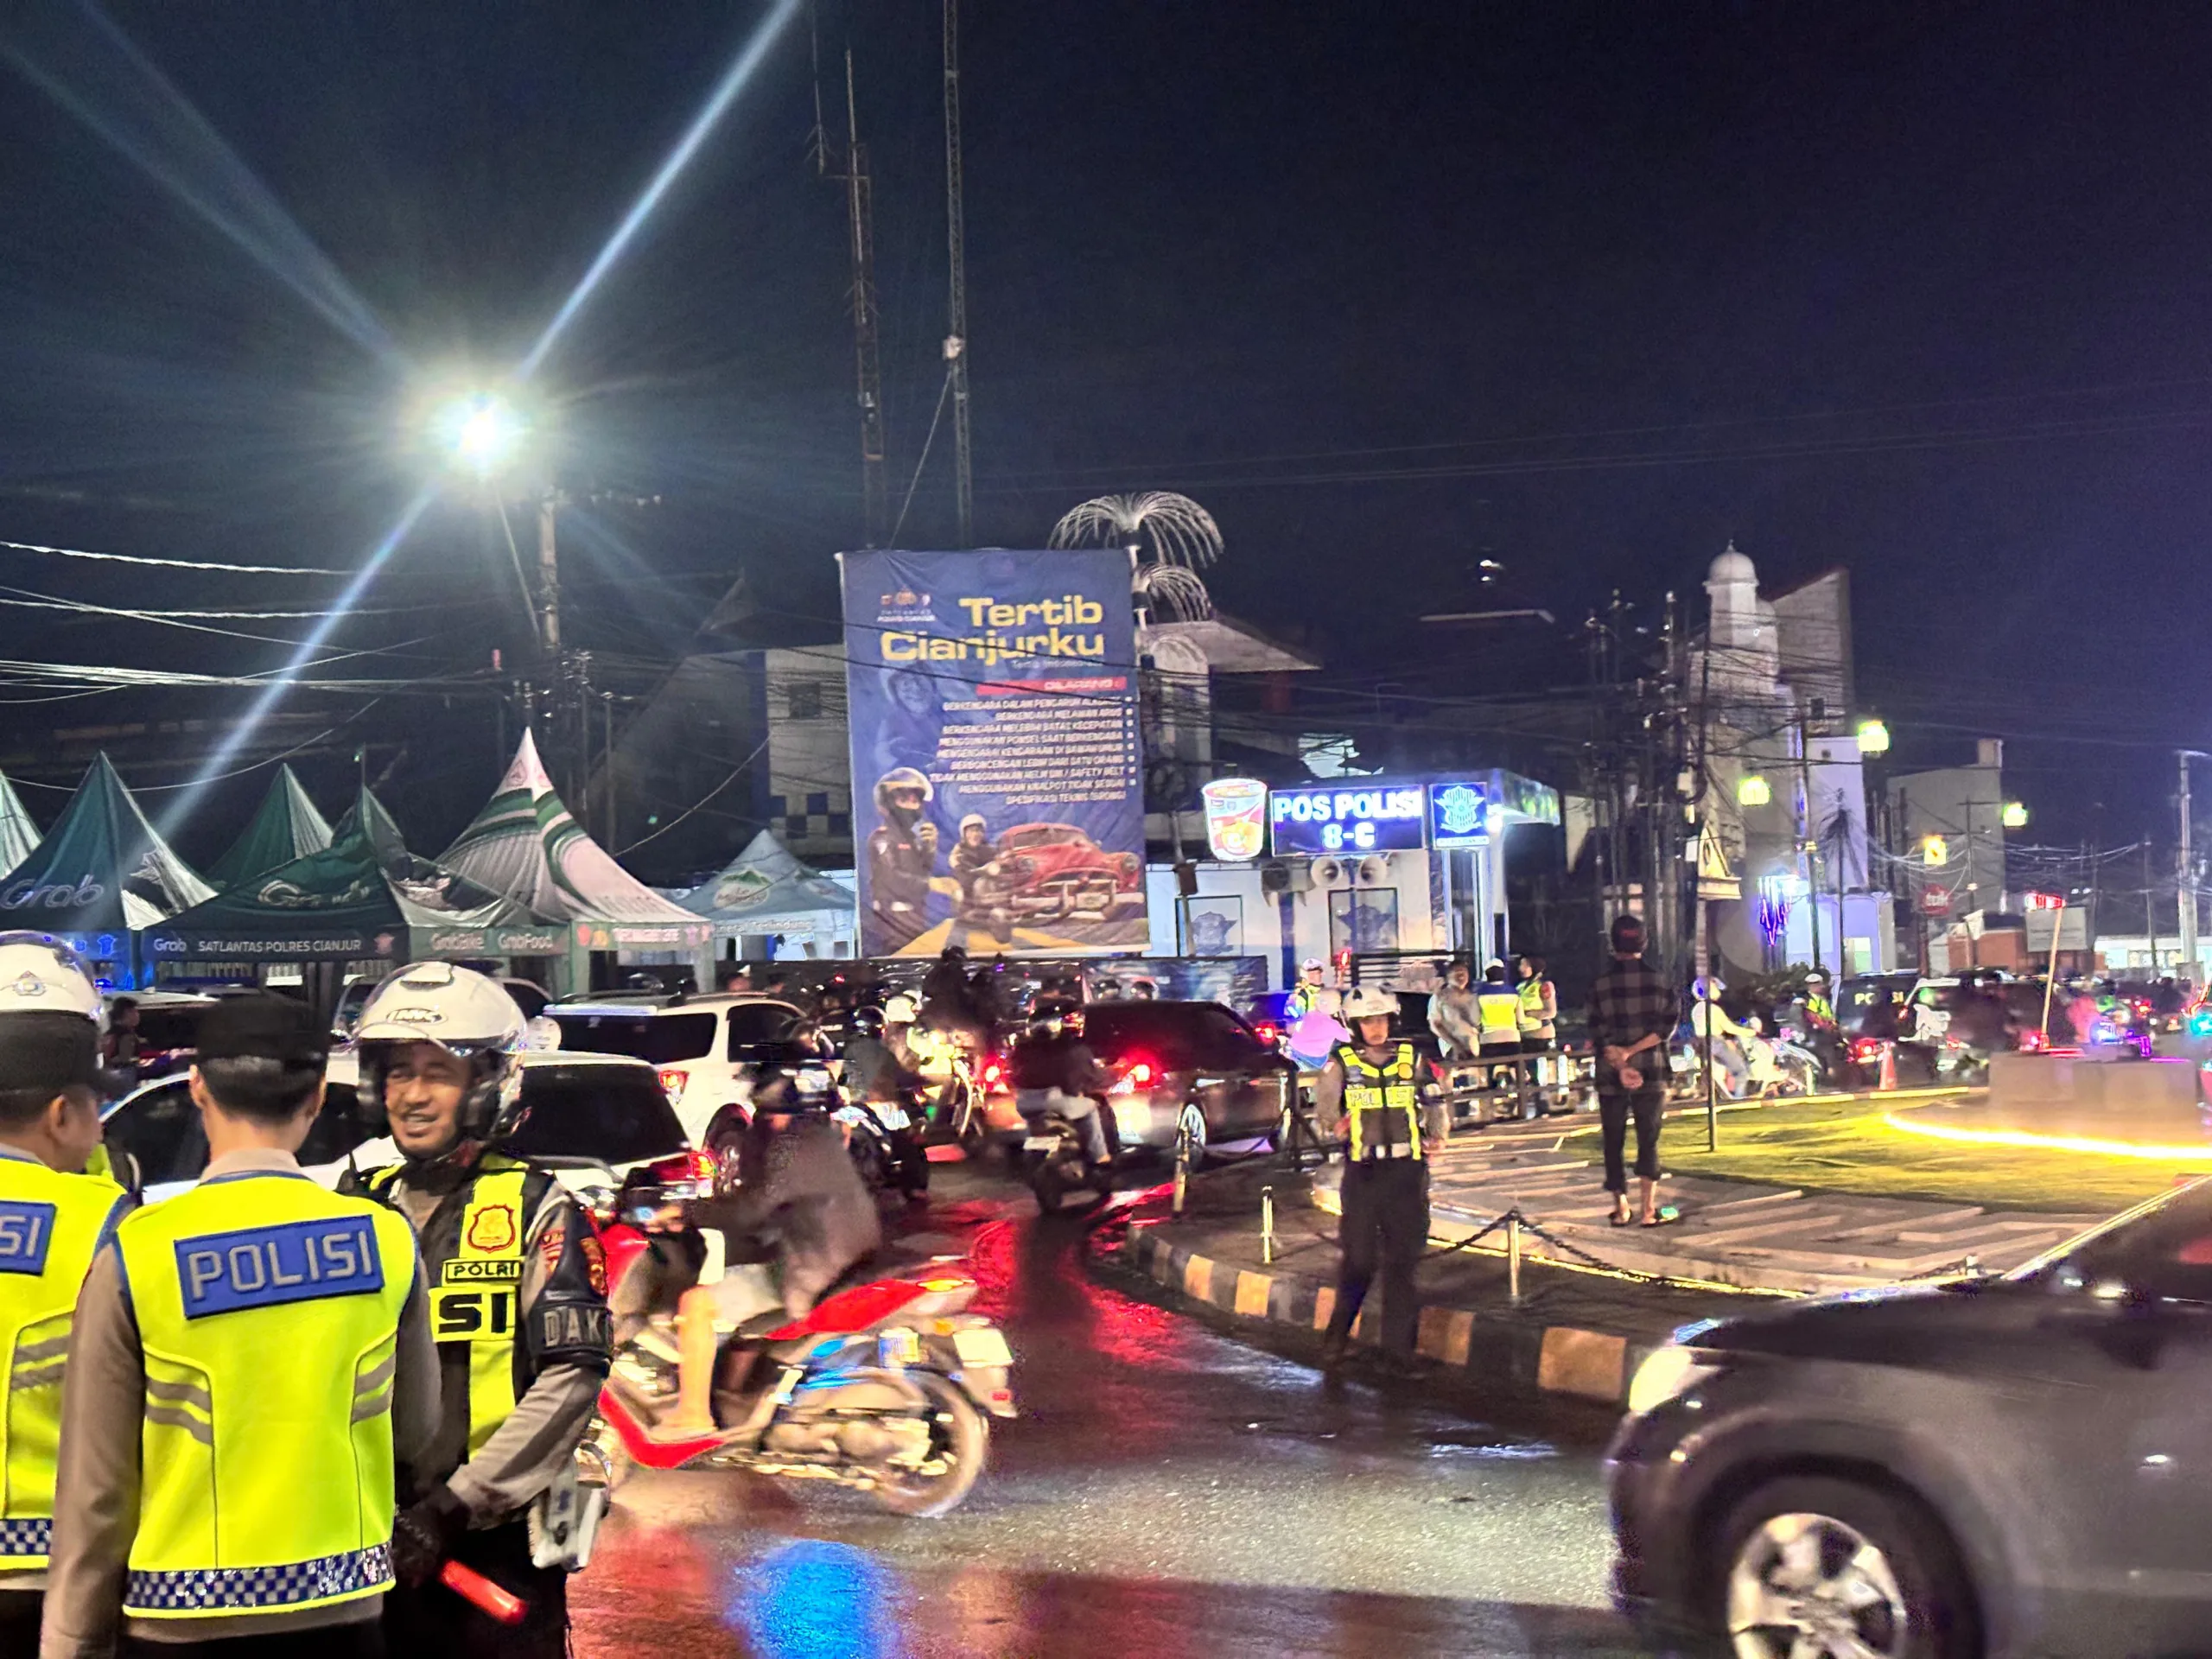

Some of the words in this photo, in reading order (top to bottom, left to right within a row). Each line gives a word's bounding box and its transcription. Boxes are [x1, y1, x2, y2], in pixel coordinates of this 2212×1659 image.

[959, 594, 1103, 626] Tertib
[880, 628, 1104, 666] Cianjurku
[1274, 793, 1332, 822] POS
[1336, 791, 1422, 819] POLISI
[1323, 823, 1376, 849] 8-C
[1, 874, 105, 910] Grab
[153, 938, 188, 951] Grab
[198, 941, 263, 952] SATLANTAS
[266, 940, 310, 951] POLRES
[313, 939, 361, 951] CIANJUR
[499, 932, 553, 949] GrabFood
[0, 1216, 41, 1258] SI
[188, 1230, 372, 1300] POLISI
[454, 1264, 515, 1277] POLRI
[438, 1293, 508, 1335] SI
[543, 1306, 610, 1347] DAK
